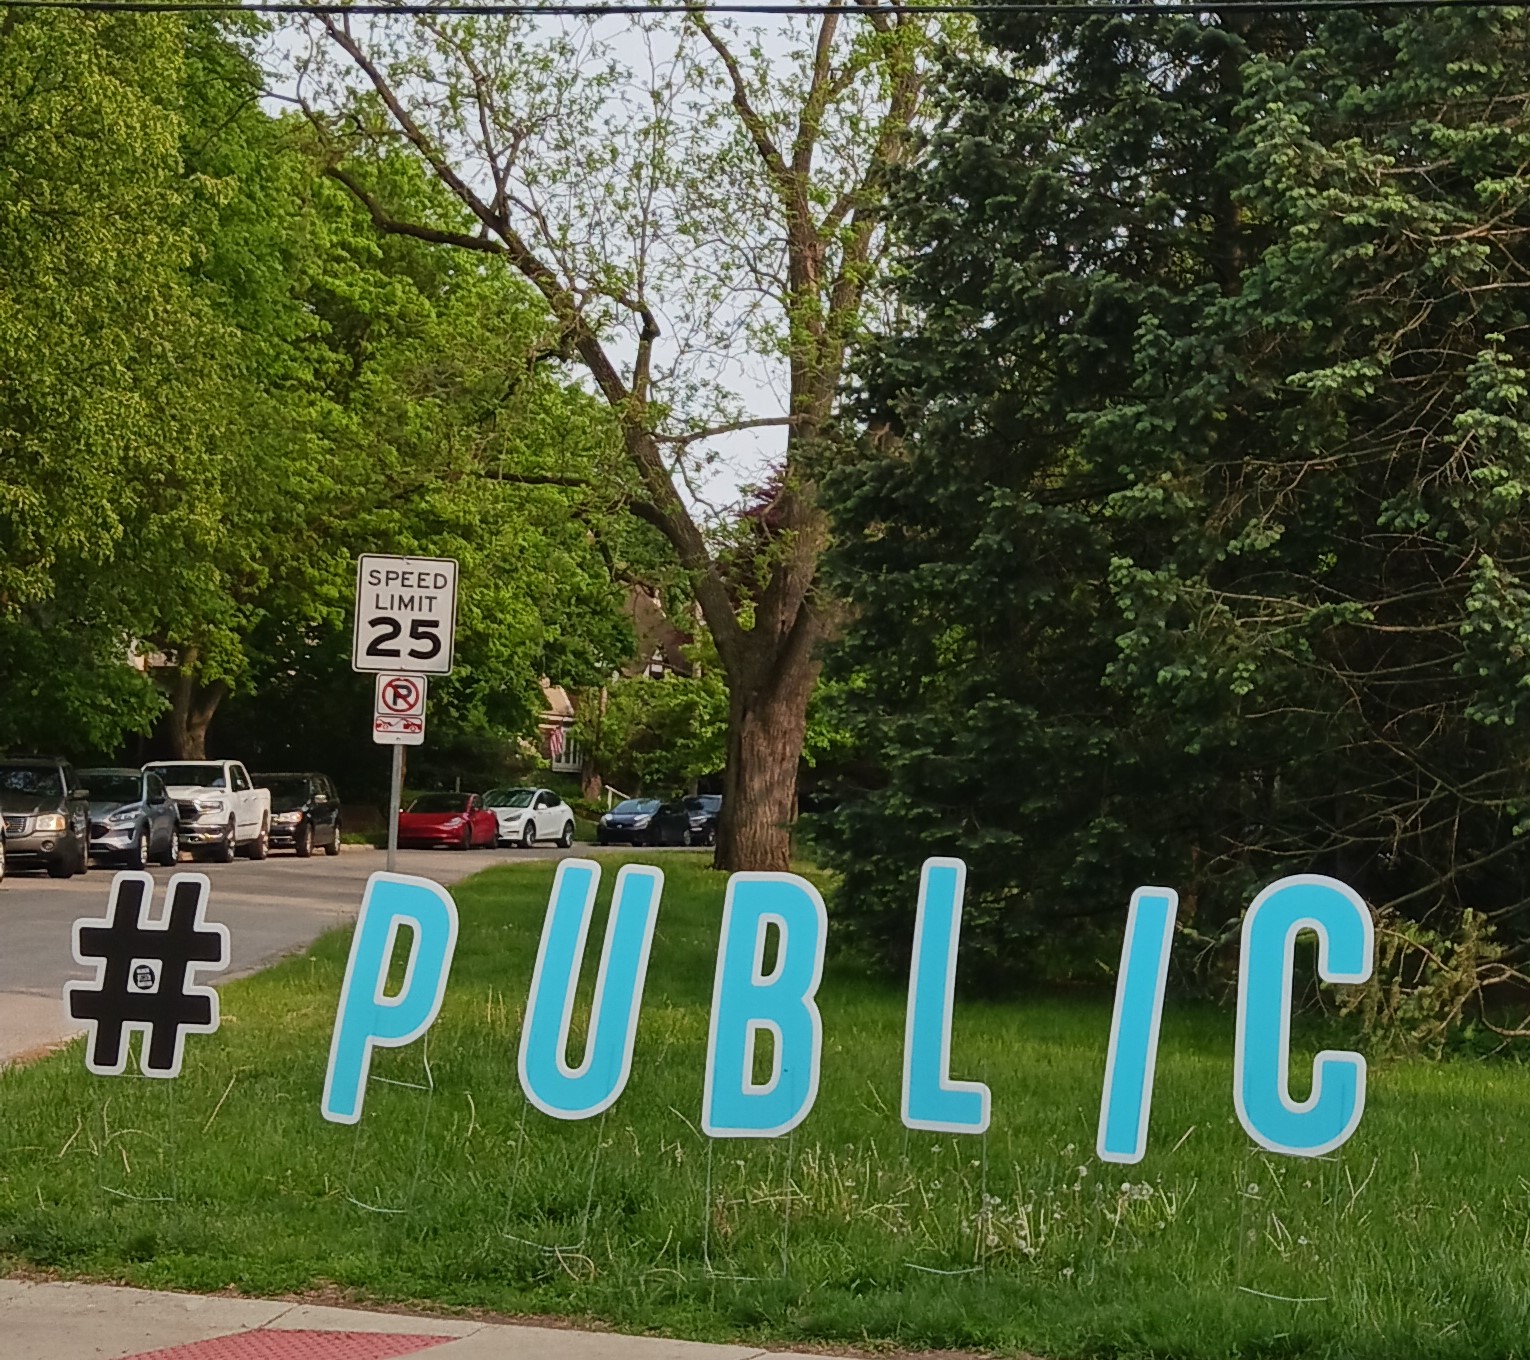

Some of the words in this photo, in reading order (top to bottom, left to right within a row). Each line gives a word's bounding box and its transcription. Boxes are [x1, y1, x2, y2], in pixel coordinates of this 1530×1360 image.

[368, 569, 448, 590] SPEED
[375, 593, 438, 613] LIMIT
[365, 616, 442, 660] 25
